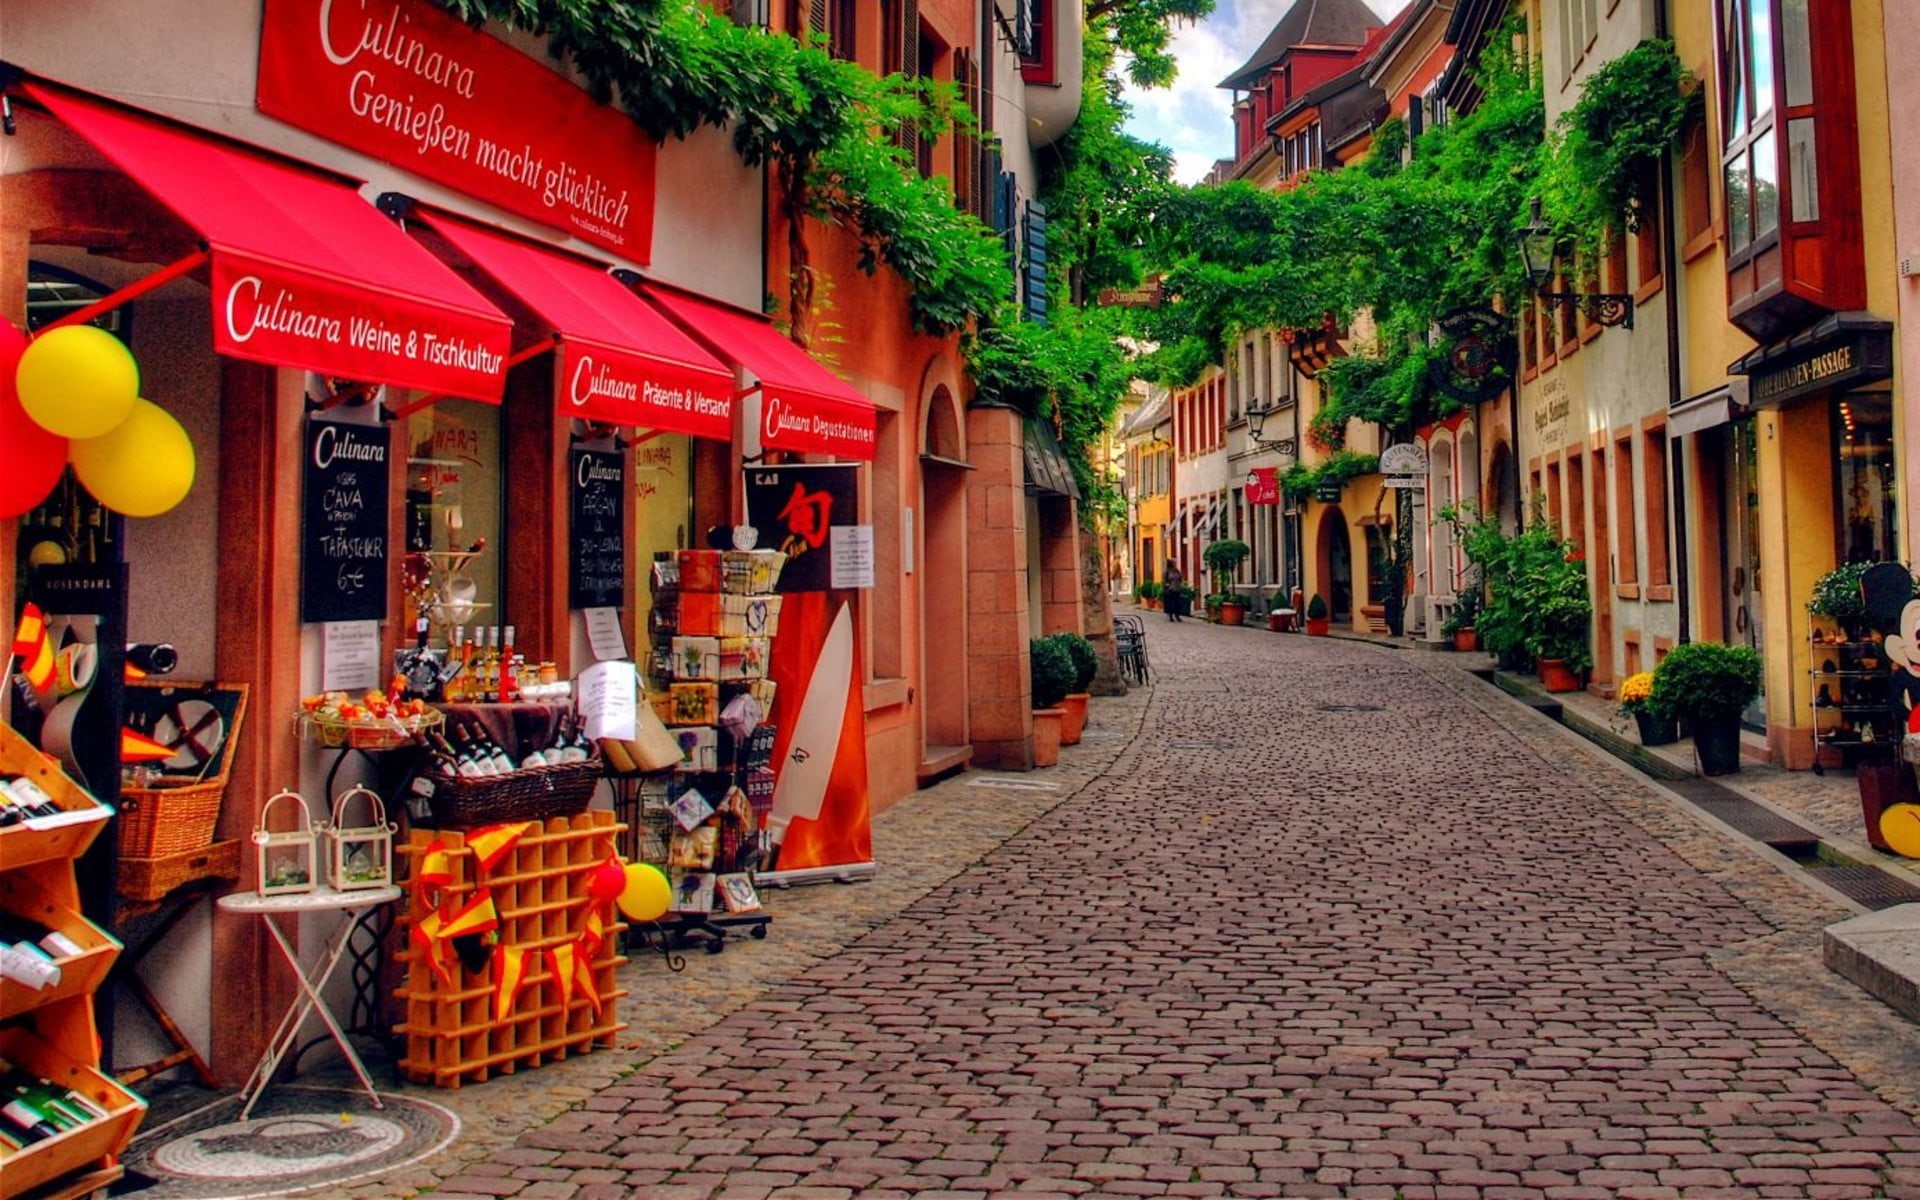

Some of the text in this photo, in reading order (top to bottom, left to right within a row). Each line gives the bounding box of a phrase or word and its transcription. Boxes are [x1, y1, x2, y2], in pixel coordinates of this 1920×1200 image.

[320, 0, 477, 98] Culinara
[350, 70, 630, 229] Genießen macht glücklich
[226, 276, 504, 374] Culinara Weine & Tischkultur
[571, 356, 731, 418] Culinara Präsente & Versand
[766, 398, 875, 443] Culinara Degustationen
[314, 426, 385, 469] Culinara
[578, 454, 621, 488] Culinara
[755, 473, 779, 485] KAI
[323, 487, 364, 511] CAVA
